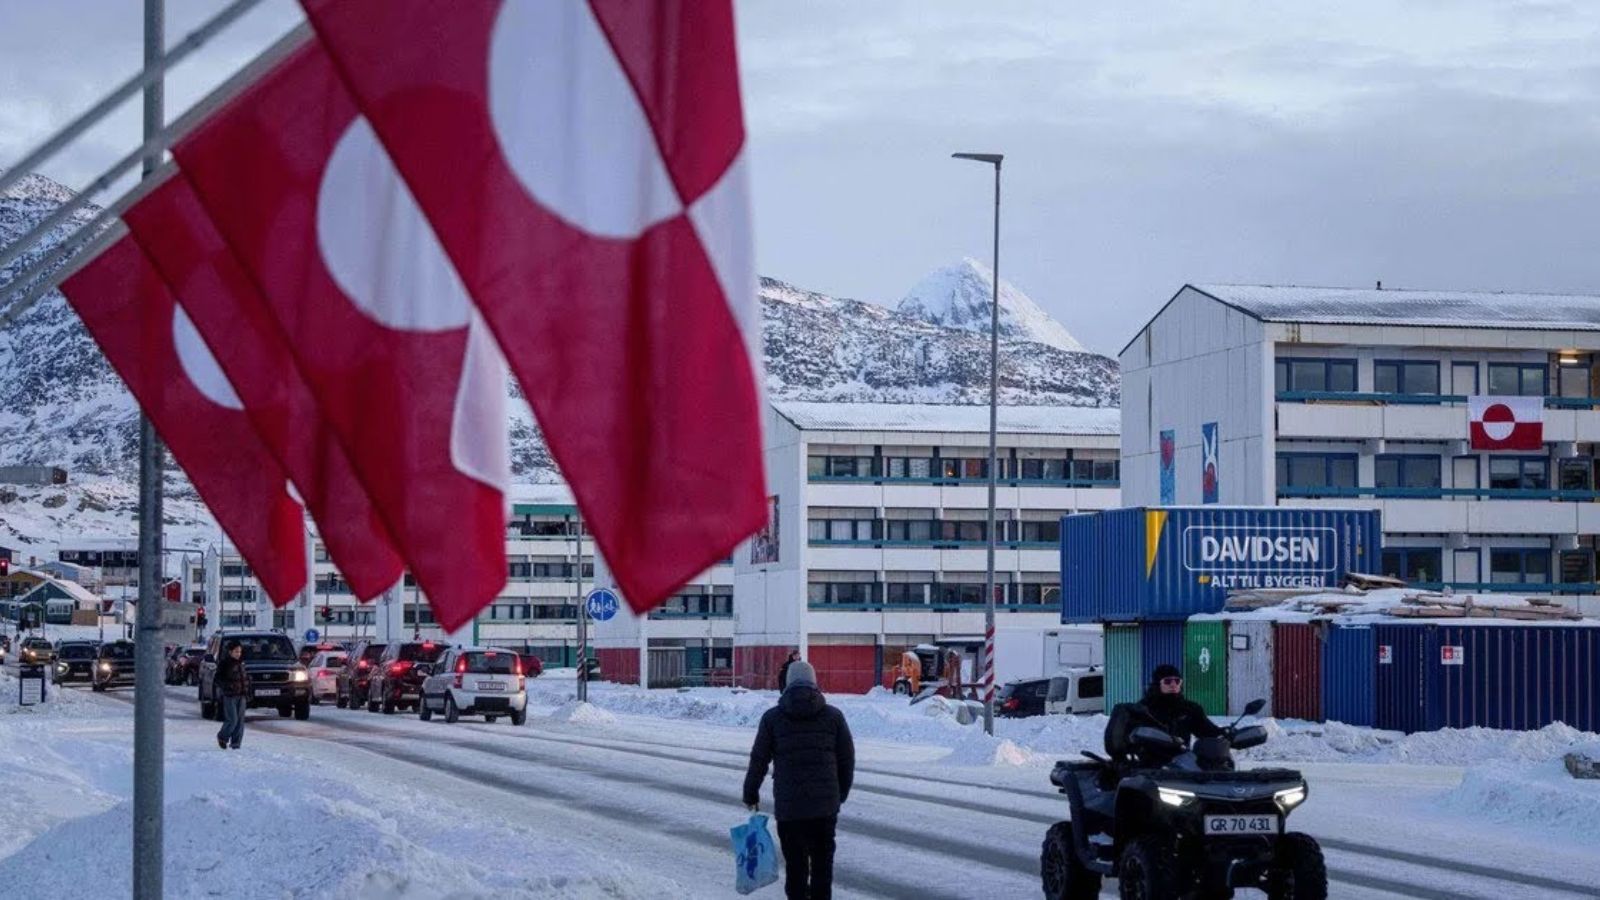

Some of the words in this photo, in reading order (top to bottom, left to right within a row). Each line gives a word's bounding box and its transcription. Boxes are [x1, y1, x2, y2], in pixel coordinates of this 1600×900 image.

[1202, 535, 1320, 562] DAVIDSEN
[1211, 575, 1237, 587] ALT
[1239, 575, 1261, 587] TIL
[1264, 575, 1325, 588] BYGGERI
[1210, 818, 1227, 831] GR
[1230, 818, 1247, 831] 70
[1249, 818, 1271, 831] 431
